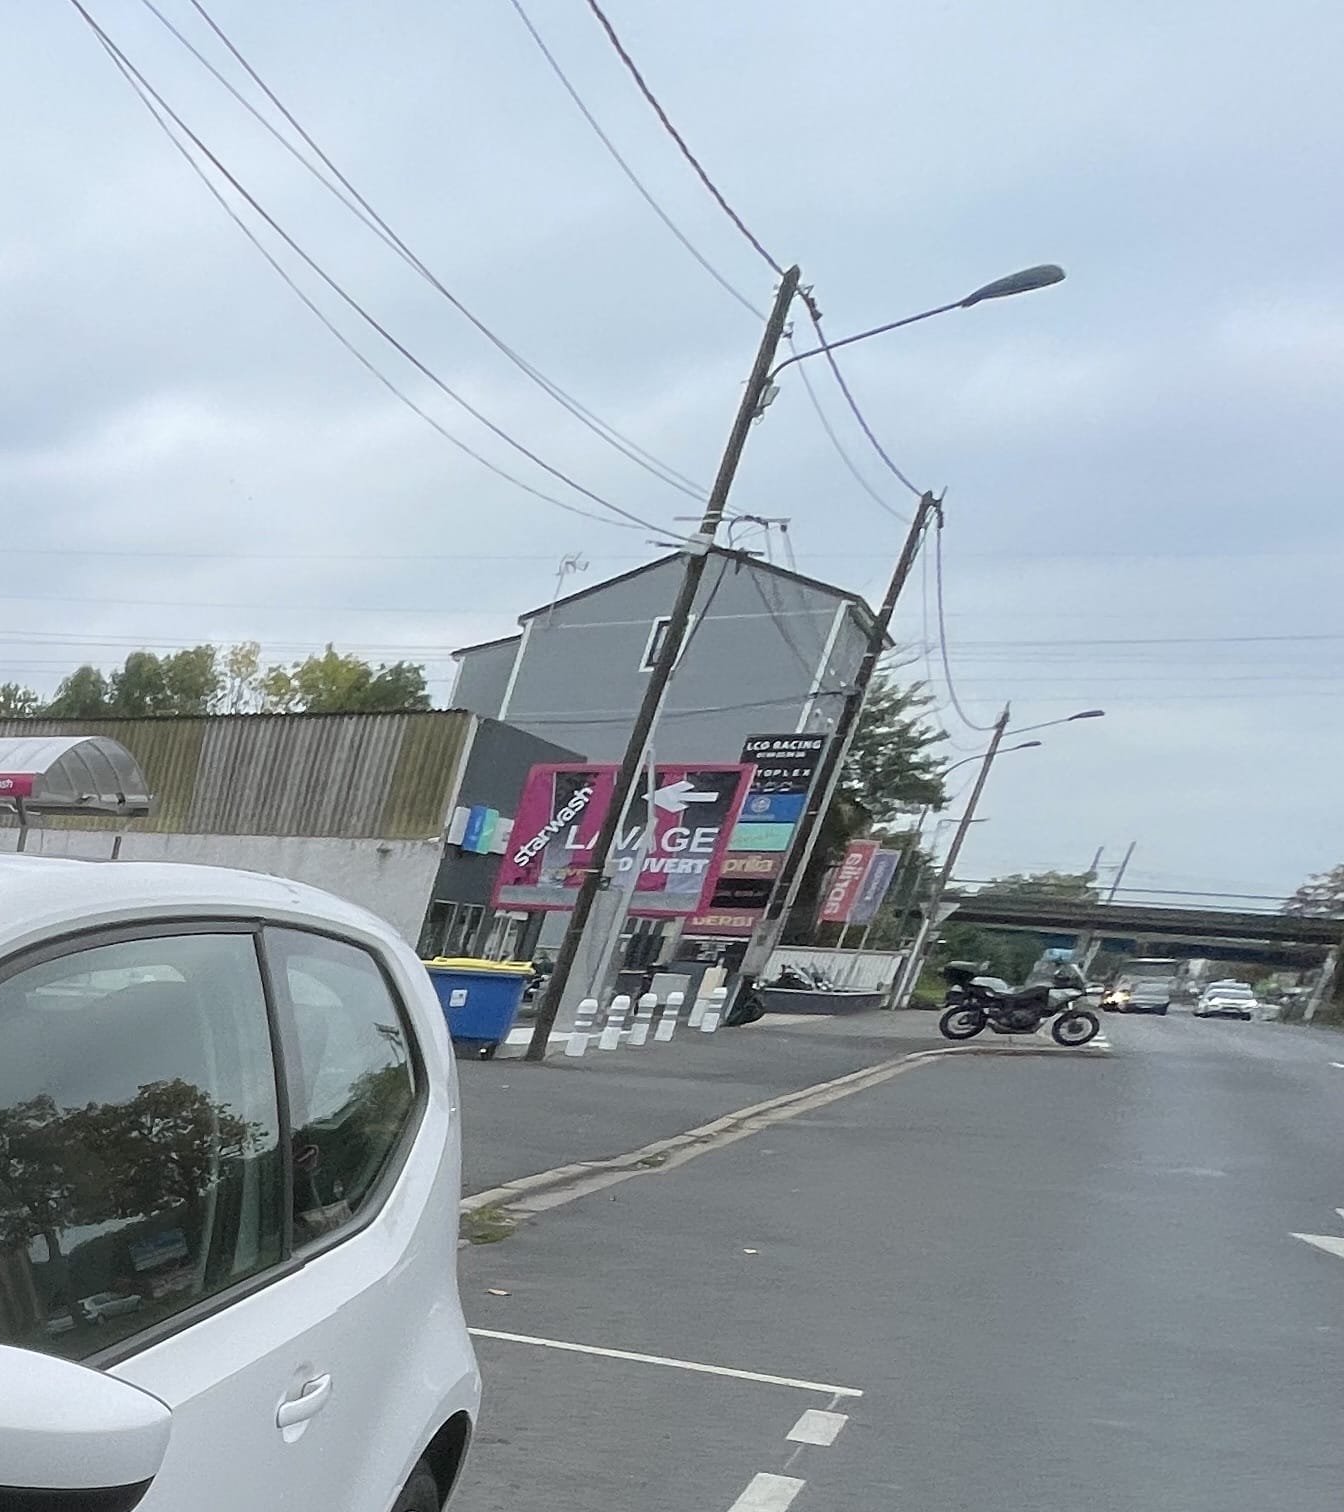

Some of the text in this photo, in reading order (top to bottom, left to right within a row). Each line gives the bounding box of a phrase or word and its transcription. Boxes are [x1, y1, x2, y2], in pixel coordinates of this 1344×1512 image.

[772, 740, 822, 751] RACING
[756, 768, 811, 777] TOPLEX
[514, 787, 593, 867] starwash
